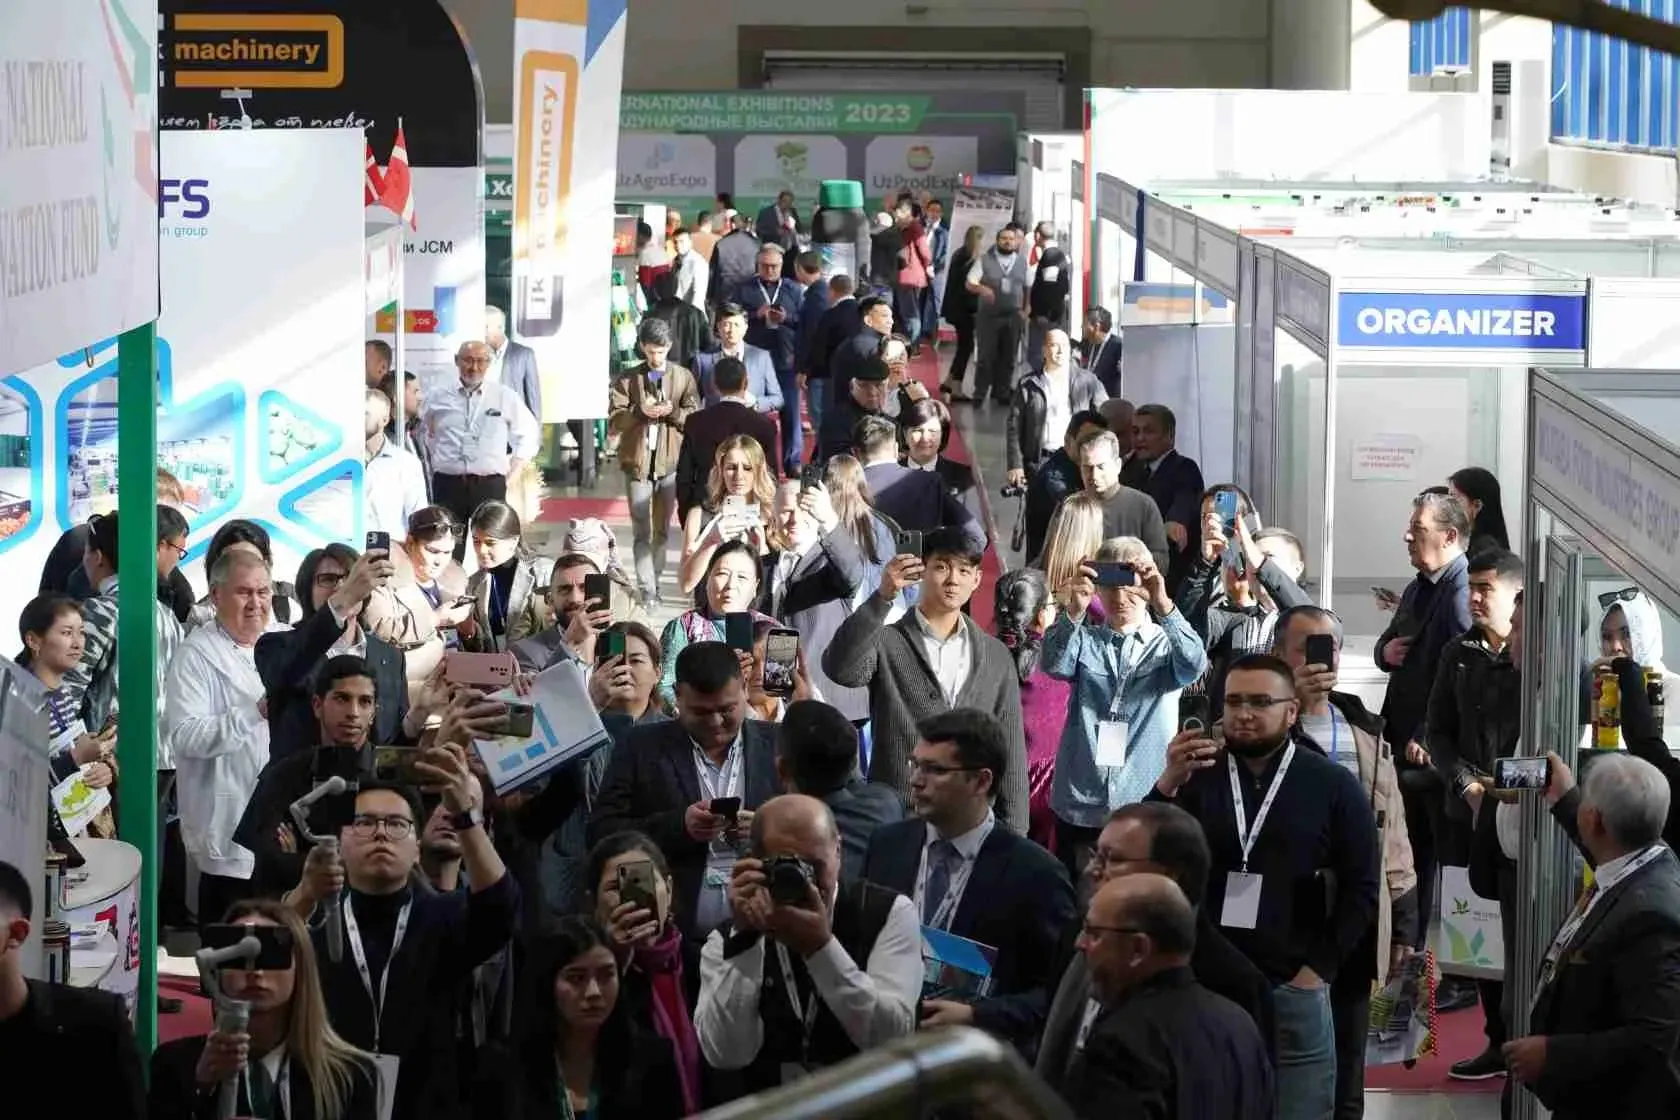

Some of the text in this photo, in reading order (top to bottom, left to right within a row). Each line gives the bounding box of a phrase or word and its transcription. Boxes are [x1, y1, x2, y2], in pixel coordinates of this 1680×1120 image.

[175, 38, 320, 64] machinery
[5, 60, 88, 149] NATIONAL
[727, 94, 835, 112] EXHIBITIONS
[845, 102, 911, 123] 2023
[746, 114, 838, 131] ВЫСТАВКИ
[535, 83, 558, 249] mchinery
[61, 196, 99, 283] FUND
[175, 227, 209, 239] group
[420, 241, 453, 254] JCM
[1357, 307, 1556, 336] ORGANIZER
